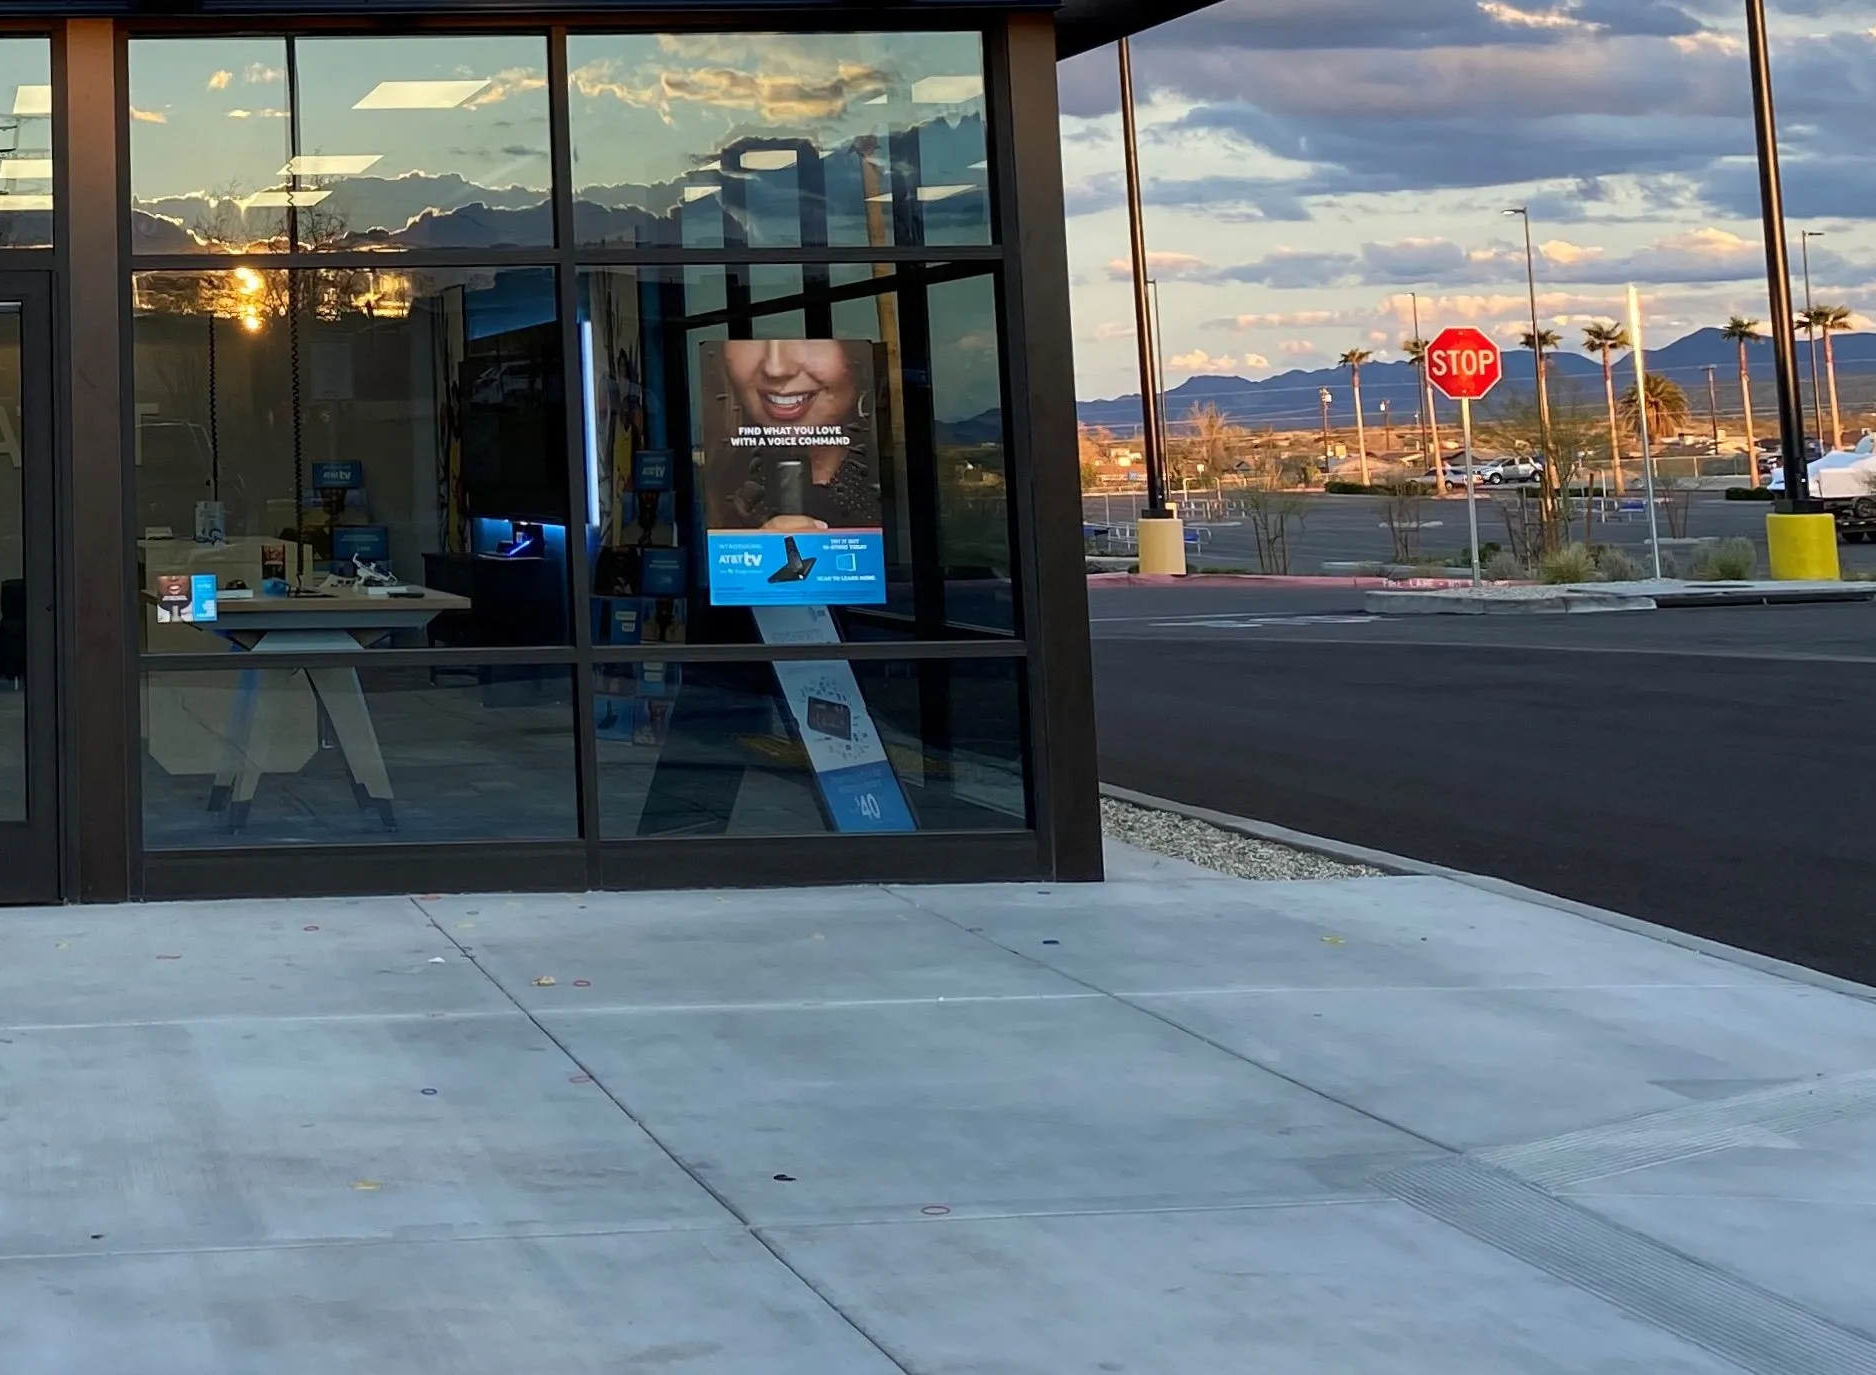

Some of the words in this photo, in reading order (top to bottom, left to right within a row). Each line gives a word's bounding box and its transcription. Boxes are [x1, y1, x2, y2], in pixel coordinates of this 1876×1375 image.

[1431, 349, 1495, 376] STOP
[738, 427, 762, 436] FIND
[763, 426, 793, 436] WHAT
[793, 426, 815, 435] YOU
[816, 425, 842, 435] LOVE
[730, 437, 757, 446] WITH
[757, 437, 766, 446] A
[767, 437, 797, 446] VOICE
[798, 436, 851, 446] COMMAND
[718, 553, 744, 565] AT&T
[743, 551, 763, 568] tv
